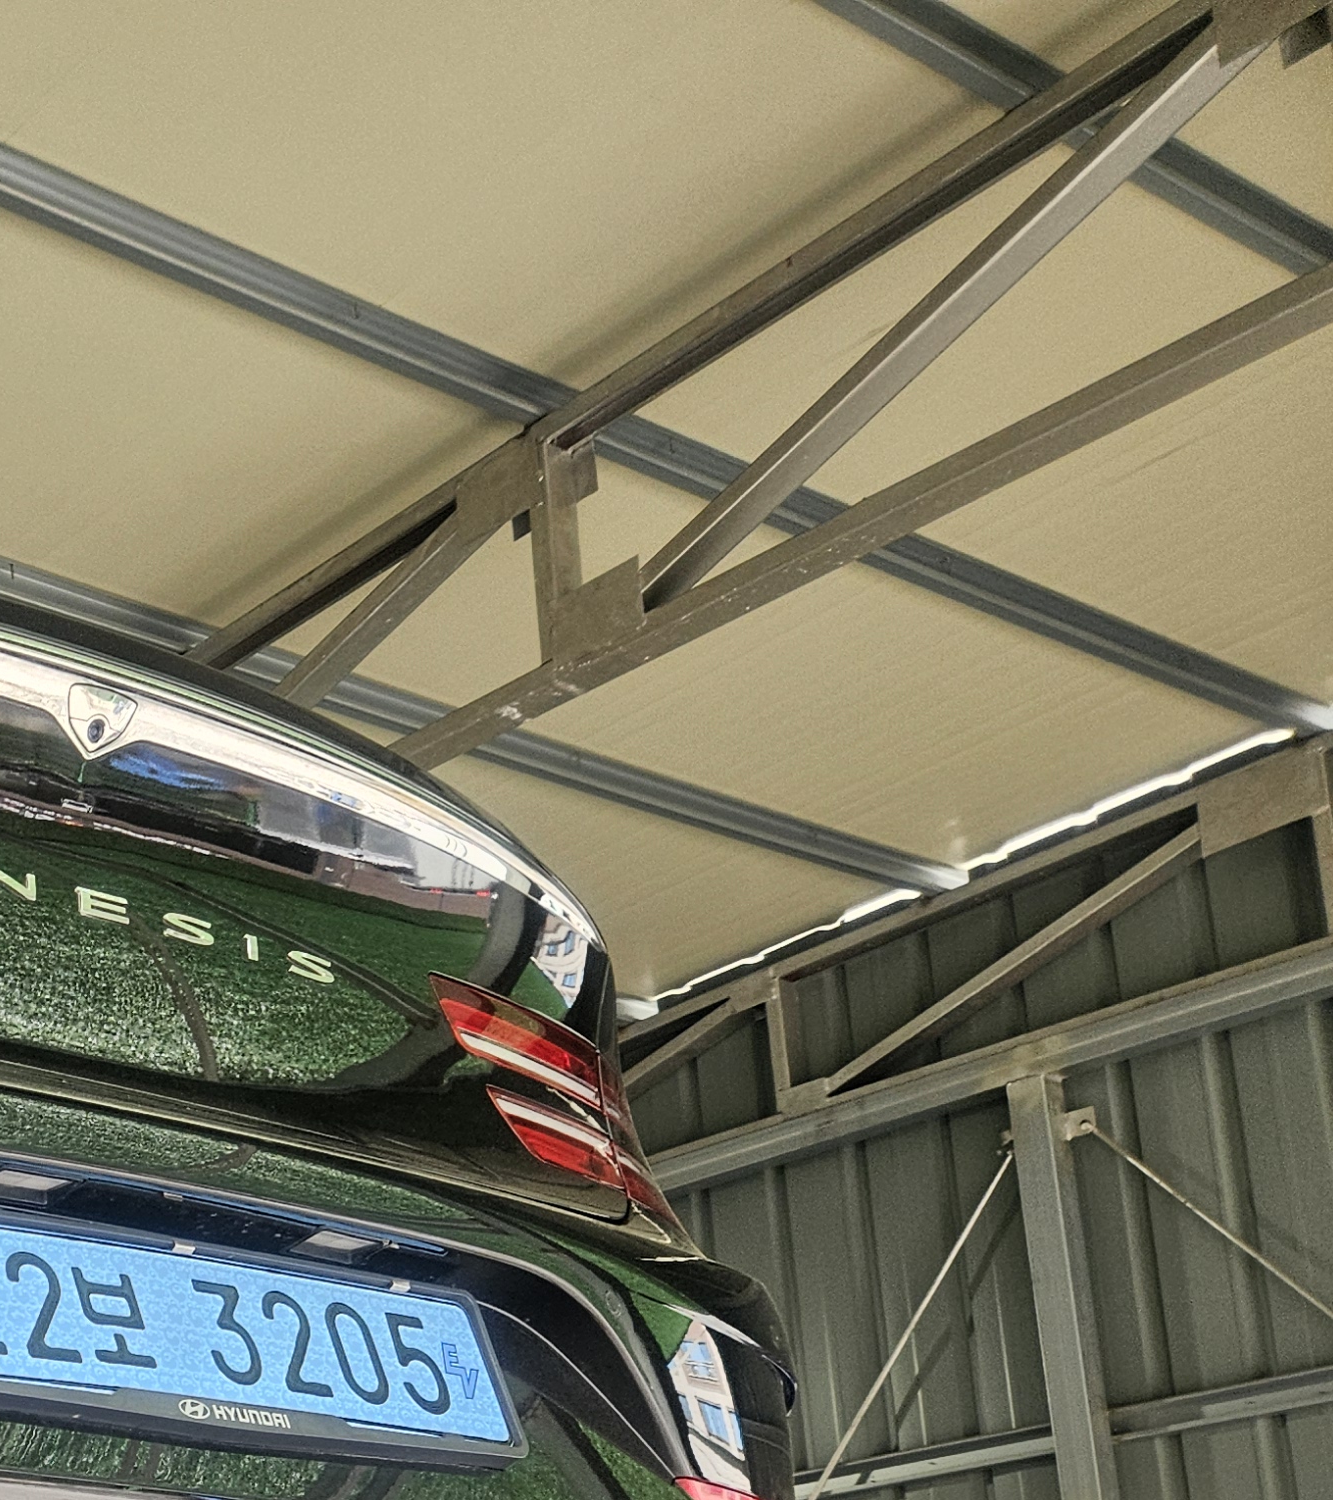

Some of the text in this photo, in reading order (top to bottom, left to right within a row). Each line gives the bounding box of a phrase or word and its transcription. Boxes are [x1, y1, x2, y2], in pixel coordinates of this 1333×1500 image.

[190, 1279, 451, 1416] 3205
[441, 1342, 480, 1400] EV
[211, 1404, 292, 1429] HYUNDAI
